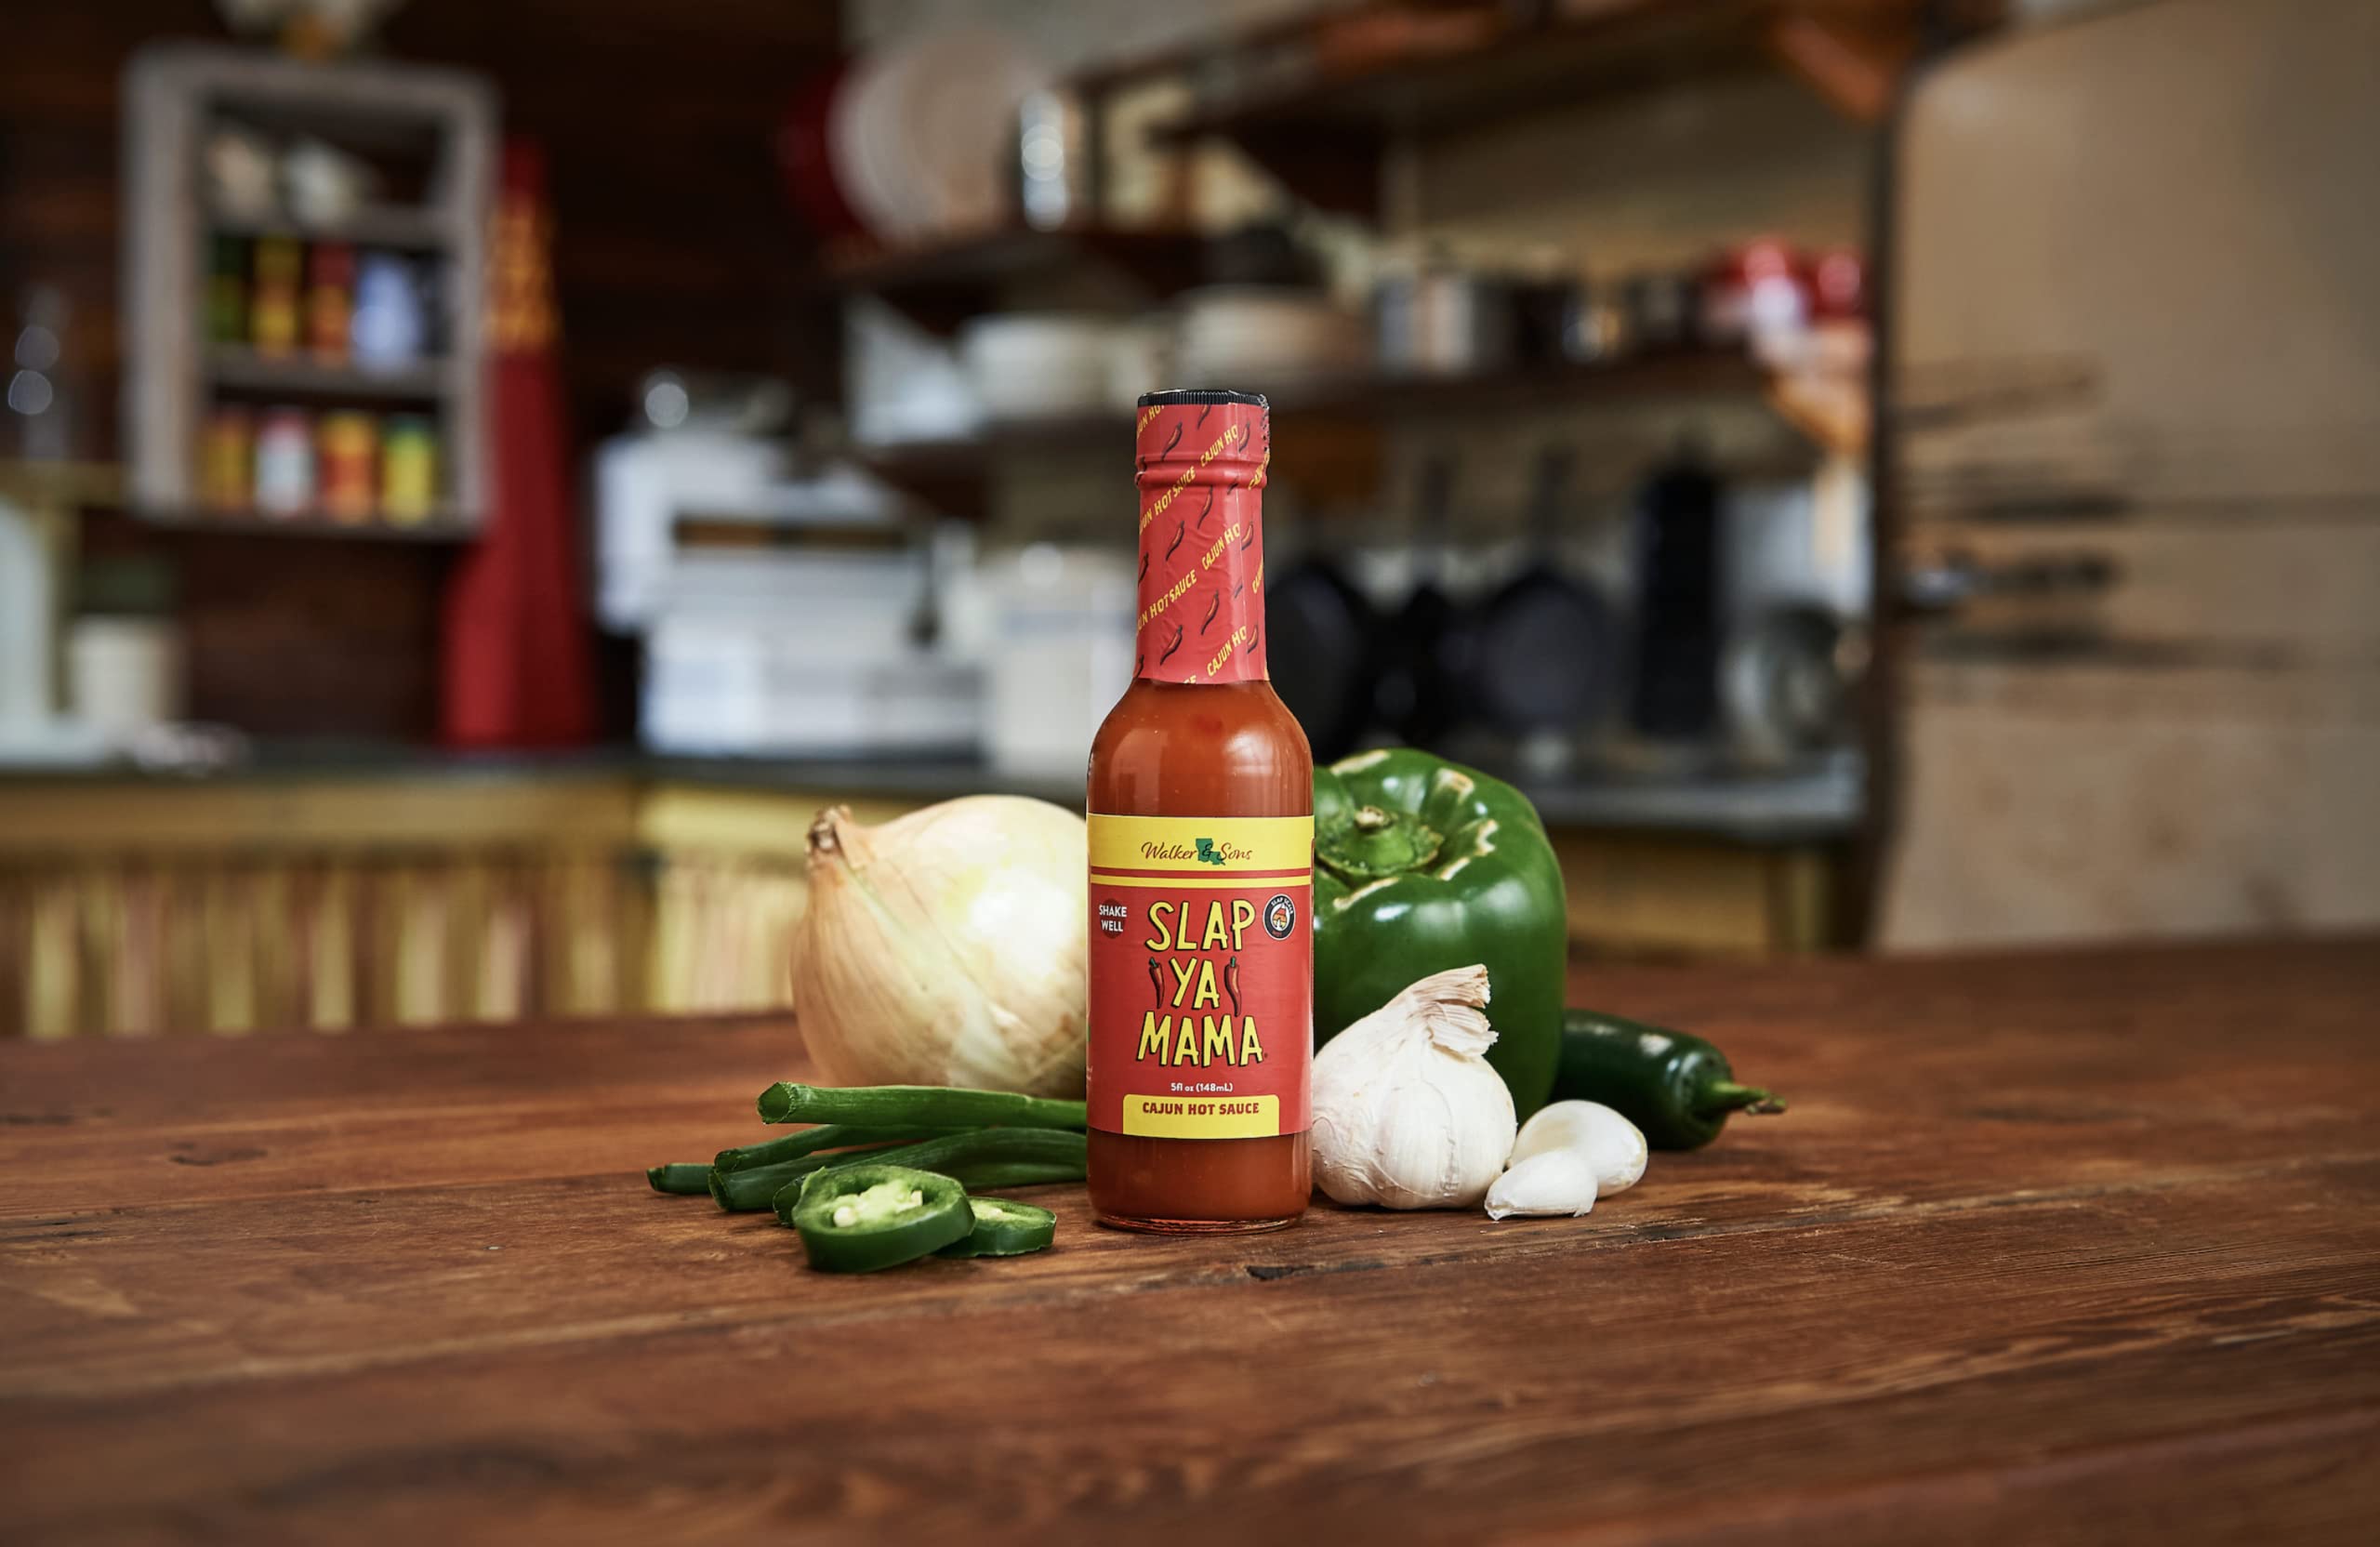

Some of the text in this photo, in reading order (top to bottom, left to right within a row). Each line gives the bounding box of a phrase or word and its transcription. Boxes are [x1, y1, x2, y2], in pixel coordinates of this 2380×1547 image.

[1149, 404, 1165, 420] HO
[1154, 489, 1172, 516] HOT
[1172, 466, 1196, 497] SAUCE
[1200, 436, 1224, 467] CAJUN
[1149, 593, 1169, 619] HOT
[1169, 569, 1197, 602] SAUCE
[1202, 536, 1225, 571] CAJUN
[1207, 640, 1233, 677] CAJUN
[1141, 841, 1252, 861] Walker & Sons
[1099, 904, 1128, 918] SHAKE
[1145, 899, 1256, 951] SLAP
[1101, 919, 1124, 932] WELL
[1170, 957, 1220, 1010] YA
[1136, 1011, 1263, 1068] MAMA
[1170, 1082, 1234, 1092] 5fl oz (148mL)
[1142, 1102, 1260, 1116] CAJUN HOT SAUCE
